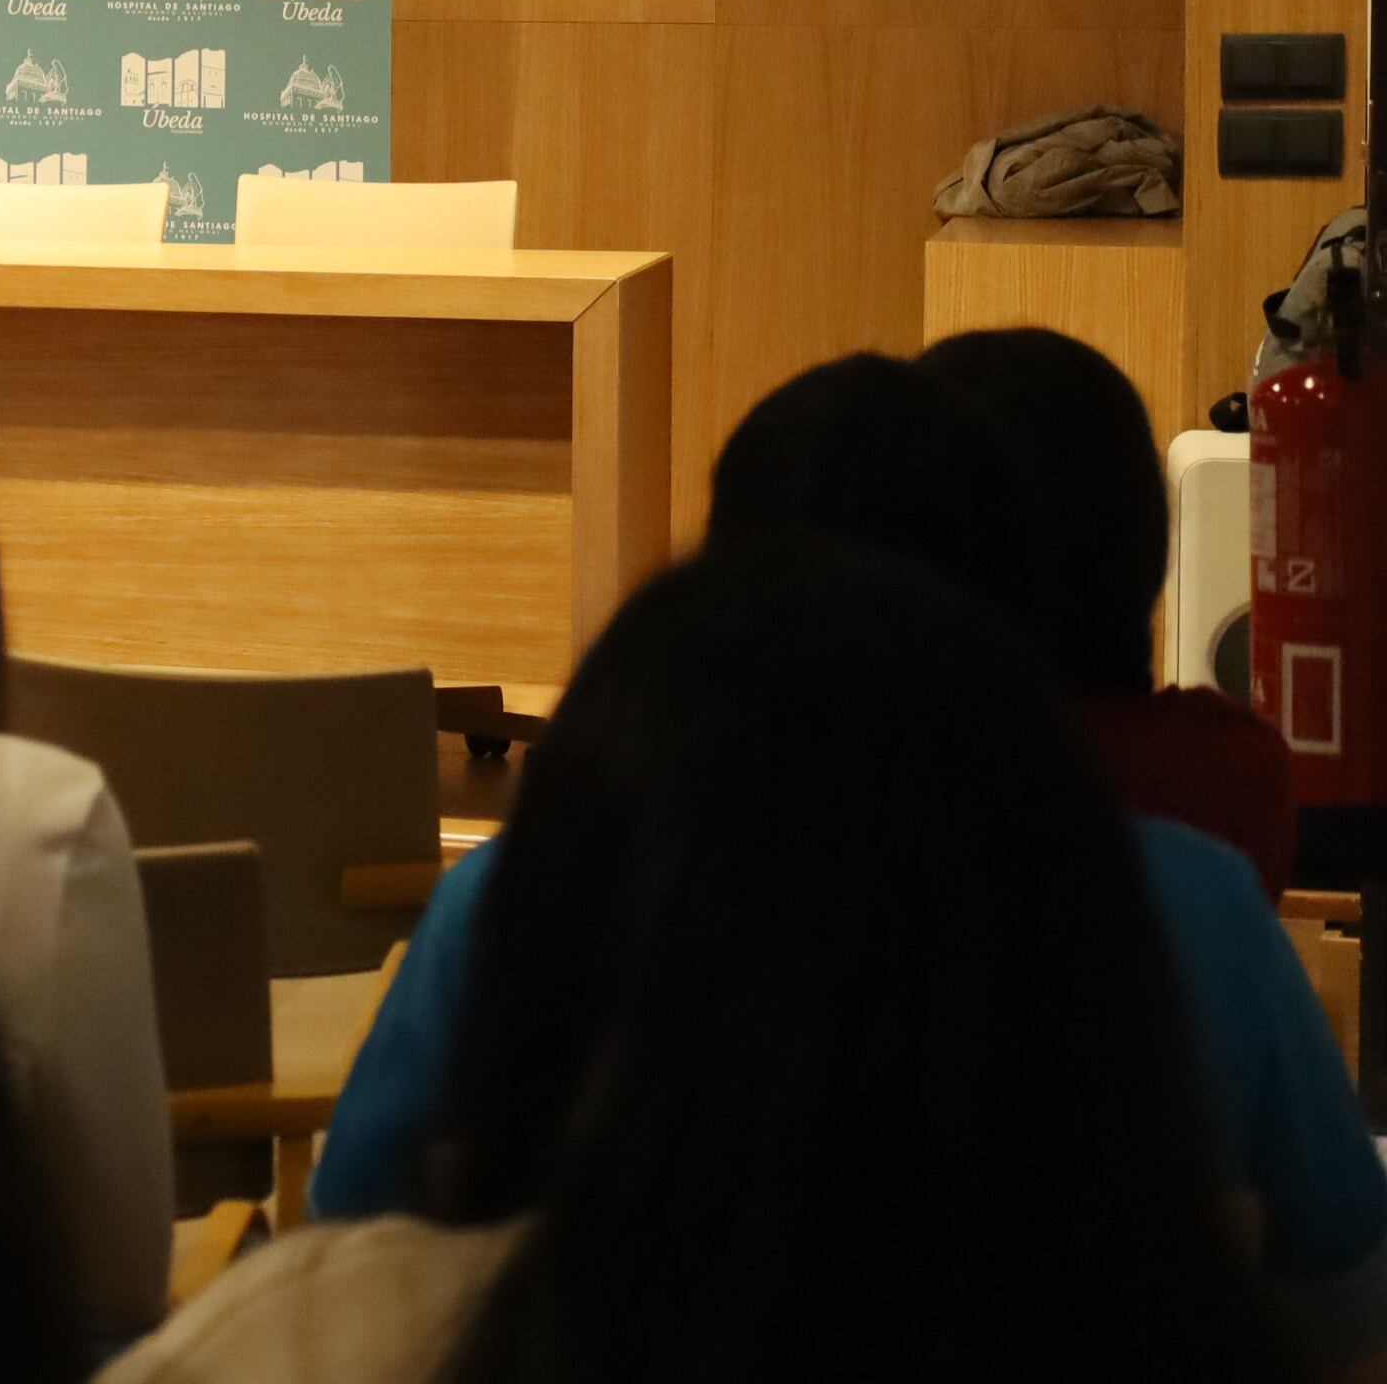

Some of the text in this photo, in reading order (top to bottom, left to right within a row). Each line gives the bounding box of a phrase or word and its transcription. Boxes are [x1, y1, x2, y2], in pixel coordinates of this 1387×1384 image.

[107, 2, 241, 12] HOSPITAL DE SANTIAGO
[27, 107, 40, 115] DE
[47, 107, 102, 117] SANTIAGO
[142, 104, 204, 129] Úbeda
[243, 112, 379, 124] HOSPITAL DE SANTIAGO
